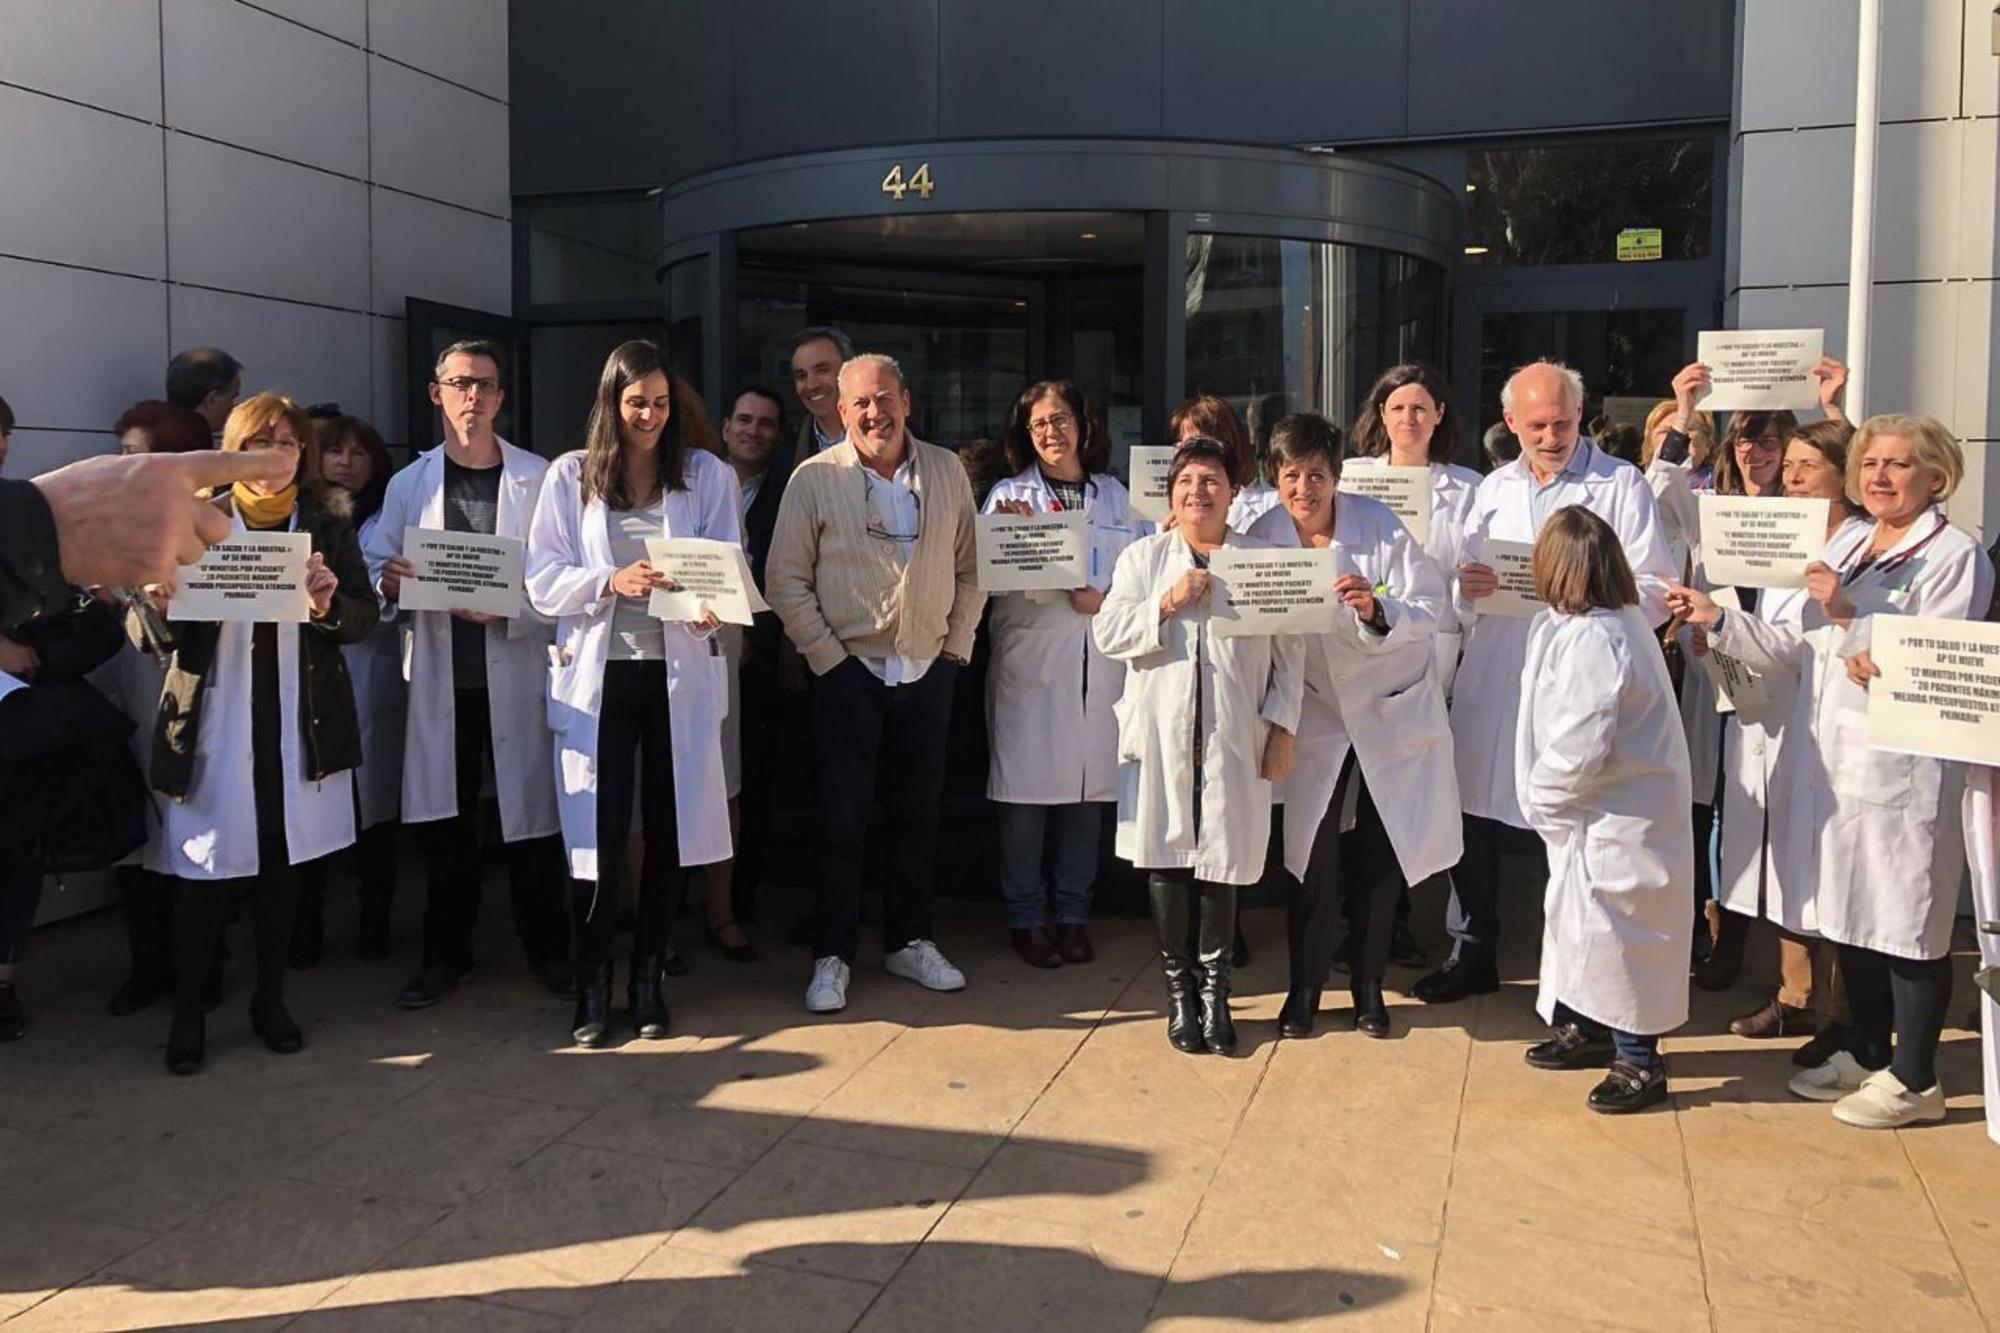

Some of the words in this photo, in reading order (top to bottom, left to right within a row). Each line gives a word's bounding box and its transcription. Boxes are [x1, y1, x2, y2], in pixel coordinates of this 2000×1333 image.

[883, 164, 933, 199] 44
[1908, 637, 1924, 648] POR
[1925, 639, 1935, 649] TU
[1936, 640, 1960, 651] SALUD
[1962, 642, 1967, 651] Y
[1968, 643, 1977, 652] LA
[1979, 644, 2000, 655] NUES
[1936, 653, 1946, 663] AP
[1948, 654, 1957, 664] SE
[1959, 655, 1984, 667] MUEVE
[1911, 667, 1920, 677] 12
[1922, 668, 1956, 680] MINUTOS
[1958, 671, 1974, 682] POR
[1931, 682, 1972, 696] PACIENTES
[1929, 695, 1989, 712] PRESUPUESTOS
